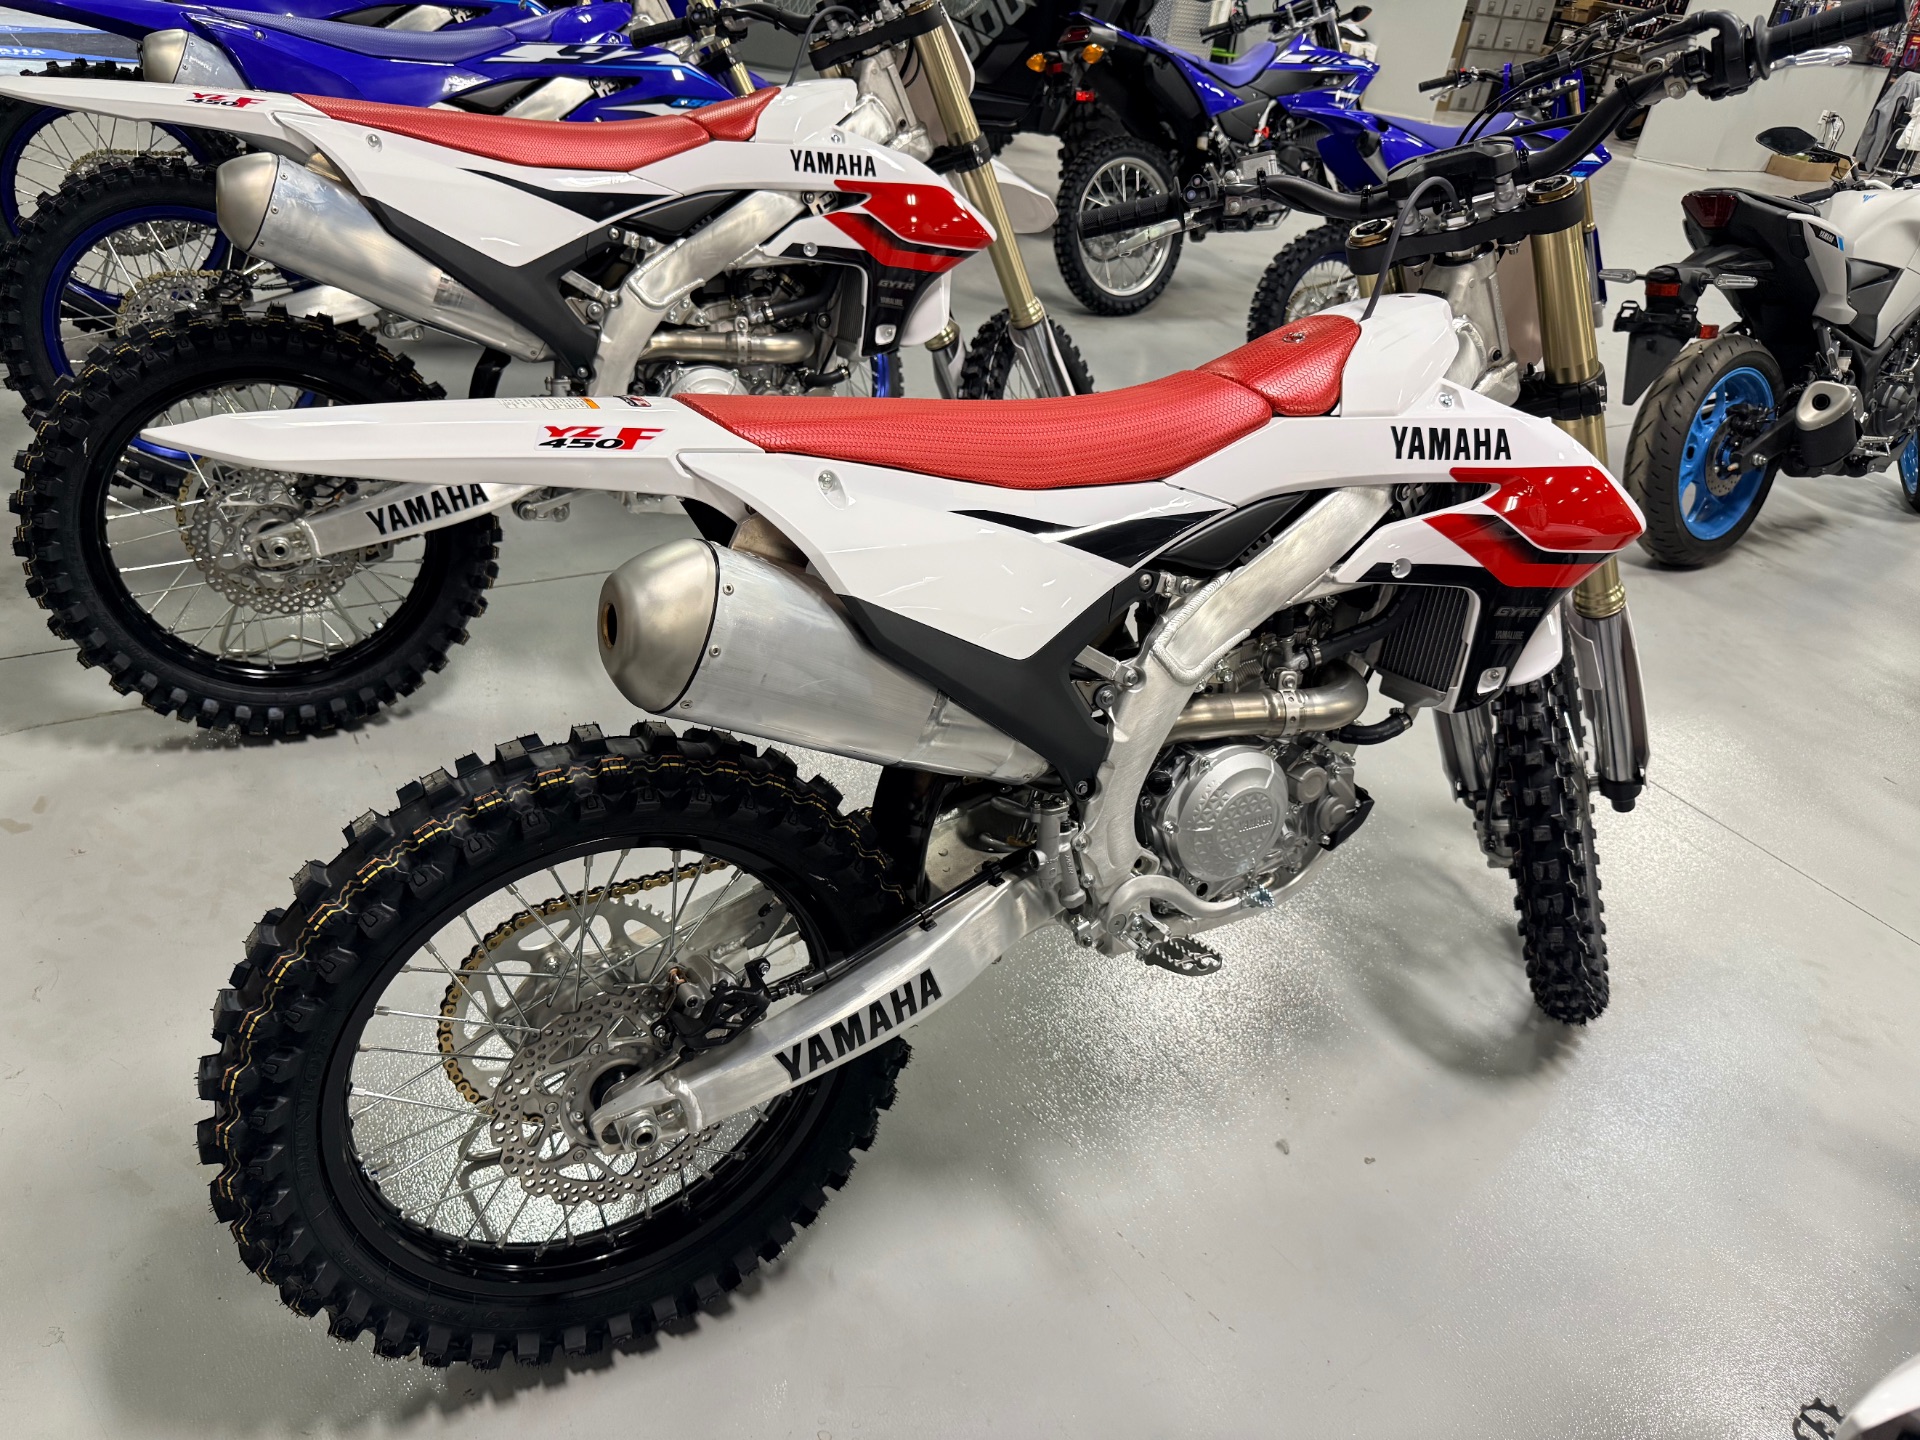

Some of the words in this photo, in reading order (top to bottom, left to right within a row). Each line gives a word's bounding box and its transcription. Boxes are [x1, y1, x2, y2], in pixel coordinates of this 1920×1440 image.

[790, 149, 877, 177] YAMAHA
[877, 279, 915, 291] GYTR
[1390, 426, 1512, 461] YAMAHA
[365, 483, 490, 535] YAMAHA
[1494, 606, 1543, 618] GYTR
[772, 967, 944, 1083] YAMAHA
